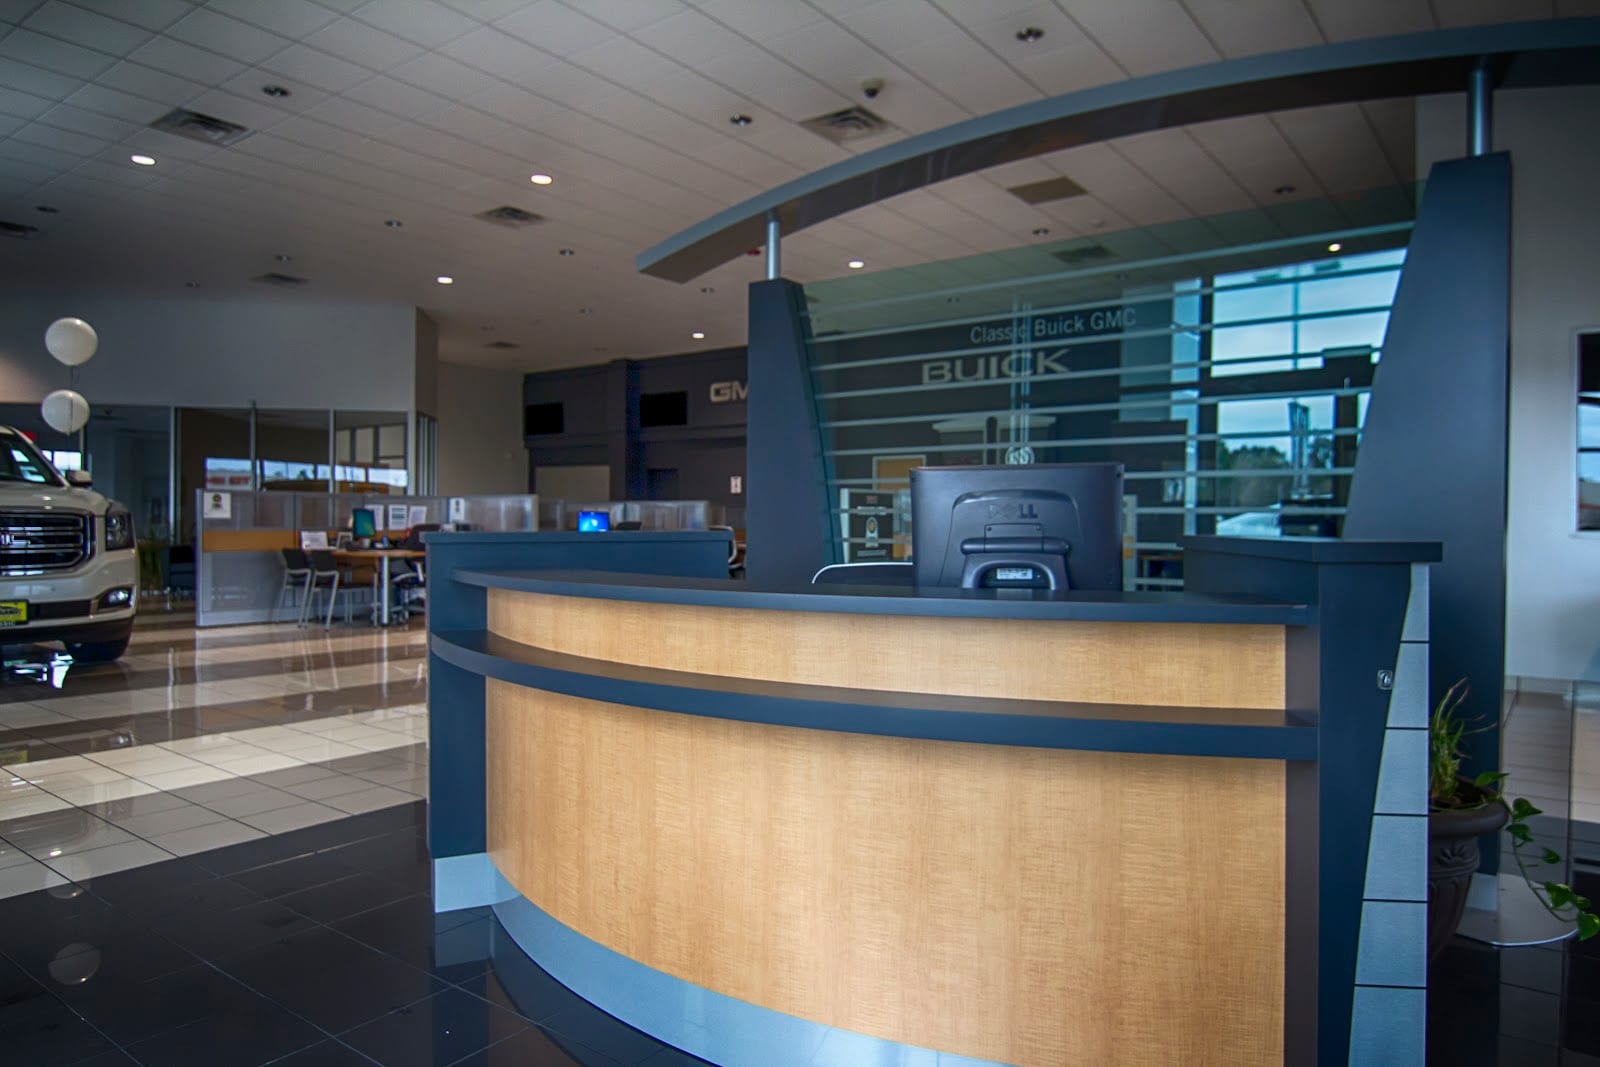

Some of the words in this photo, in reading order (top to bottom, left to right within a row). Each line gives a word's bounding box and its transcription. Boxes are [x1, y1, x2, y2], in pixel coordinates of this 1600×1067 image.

[969, 324, 1027, 344] Classic
[1034, 315, 1085, 337] Buick
[1089, 308, 1137, 330] GMC
[922, 349, 1070, 385] BUICK
[709, 381, 749, 402] GM
